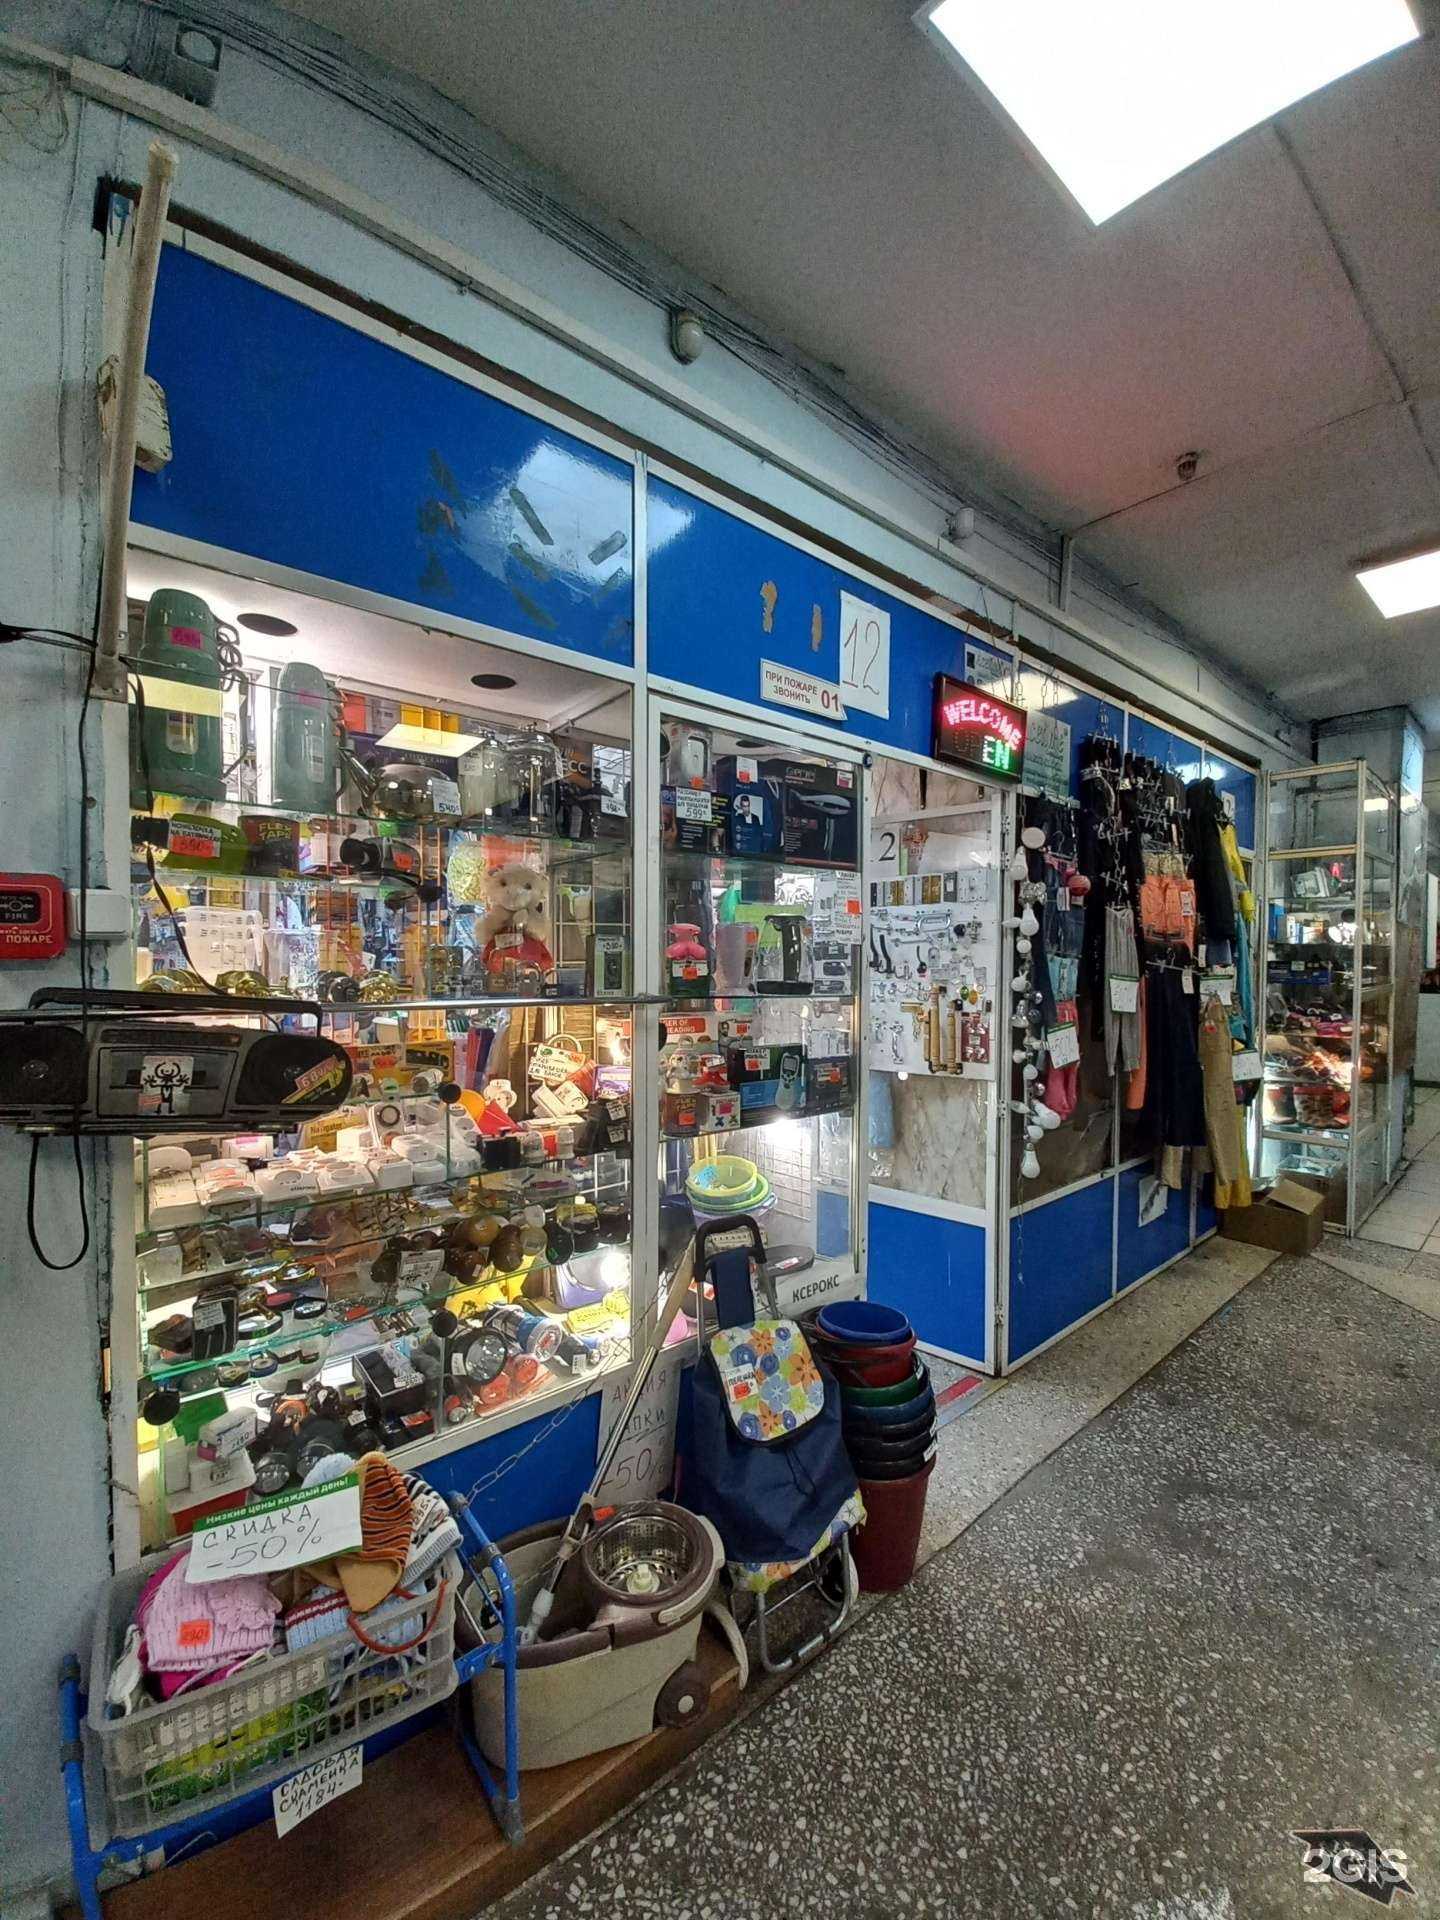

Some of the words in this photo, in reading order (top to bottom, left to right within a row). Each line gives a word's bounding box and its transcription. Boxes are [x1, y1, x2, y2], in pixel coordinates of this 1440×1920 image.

[843, 618, 880, 695] 12
[765, 670, 783, 682] ПРИ
[784, 676, 818, 695] ПОЖАРЕ
[773, 685, 811, 704] ЗВОНИТЬ
[821, 689, 839, 712] 01
[943, 699, 1022, 750] WELCOME
[6, 934, 53, 944] ПОЖАРЕ
[792, 1274, 840, 1303] КСЕРОКС
[206, 1507, 247, 1524] Низкие
[249, 1499, 277, 1515] цены
[278, 1488, 319, 1507] каждый
[321, 1476, 348, 1494] день!
[203, 1504, 312, 1549] СКИДКА
[281, 1746, 360, 1797] САДОВАЯ
